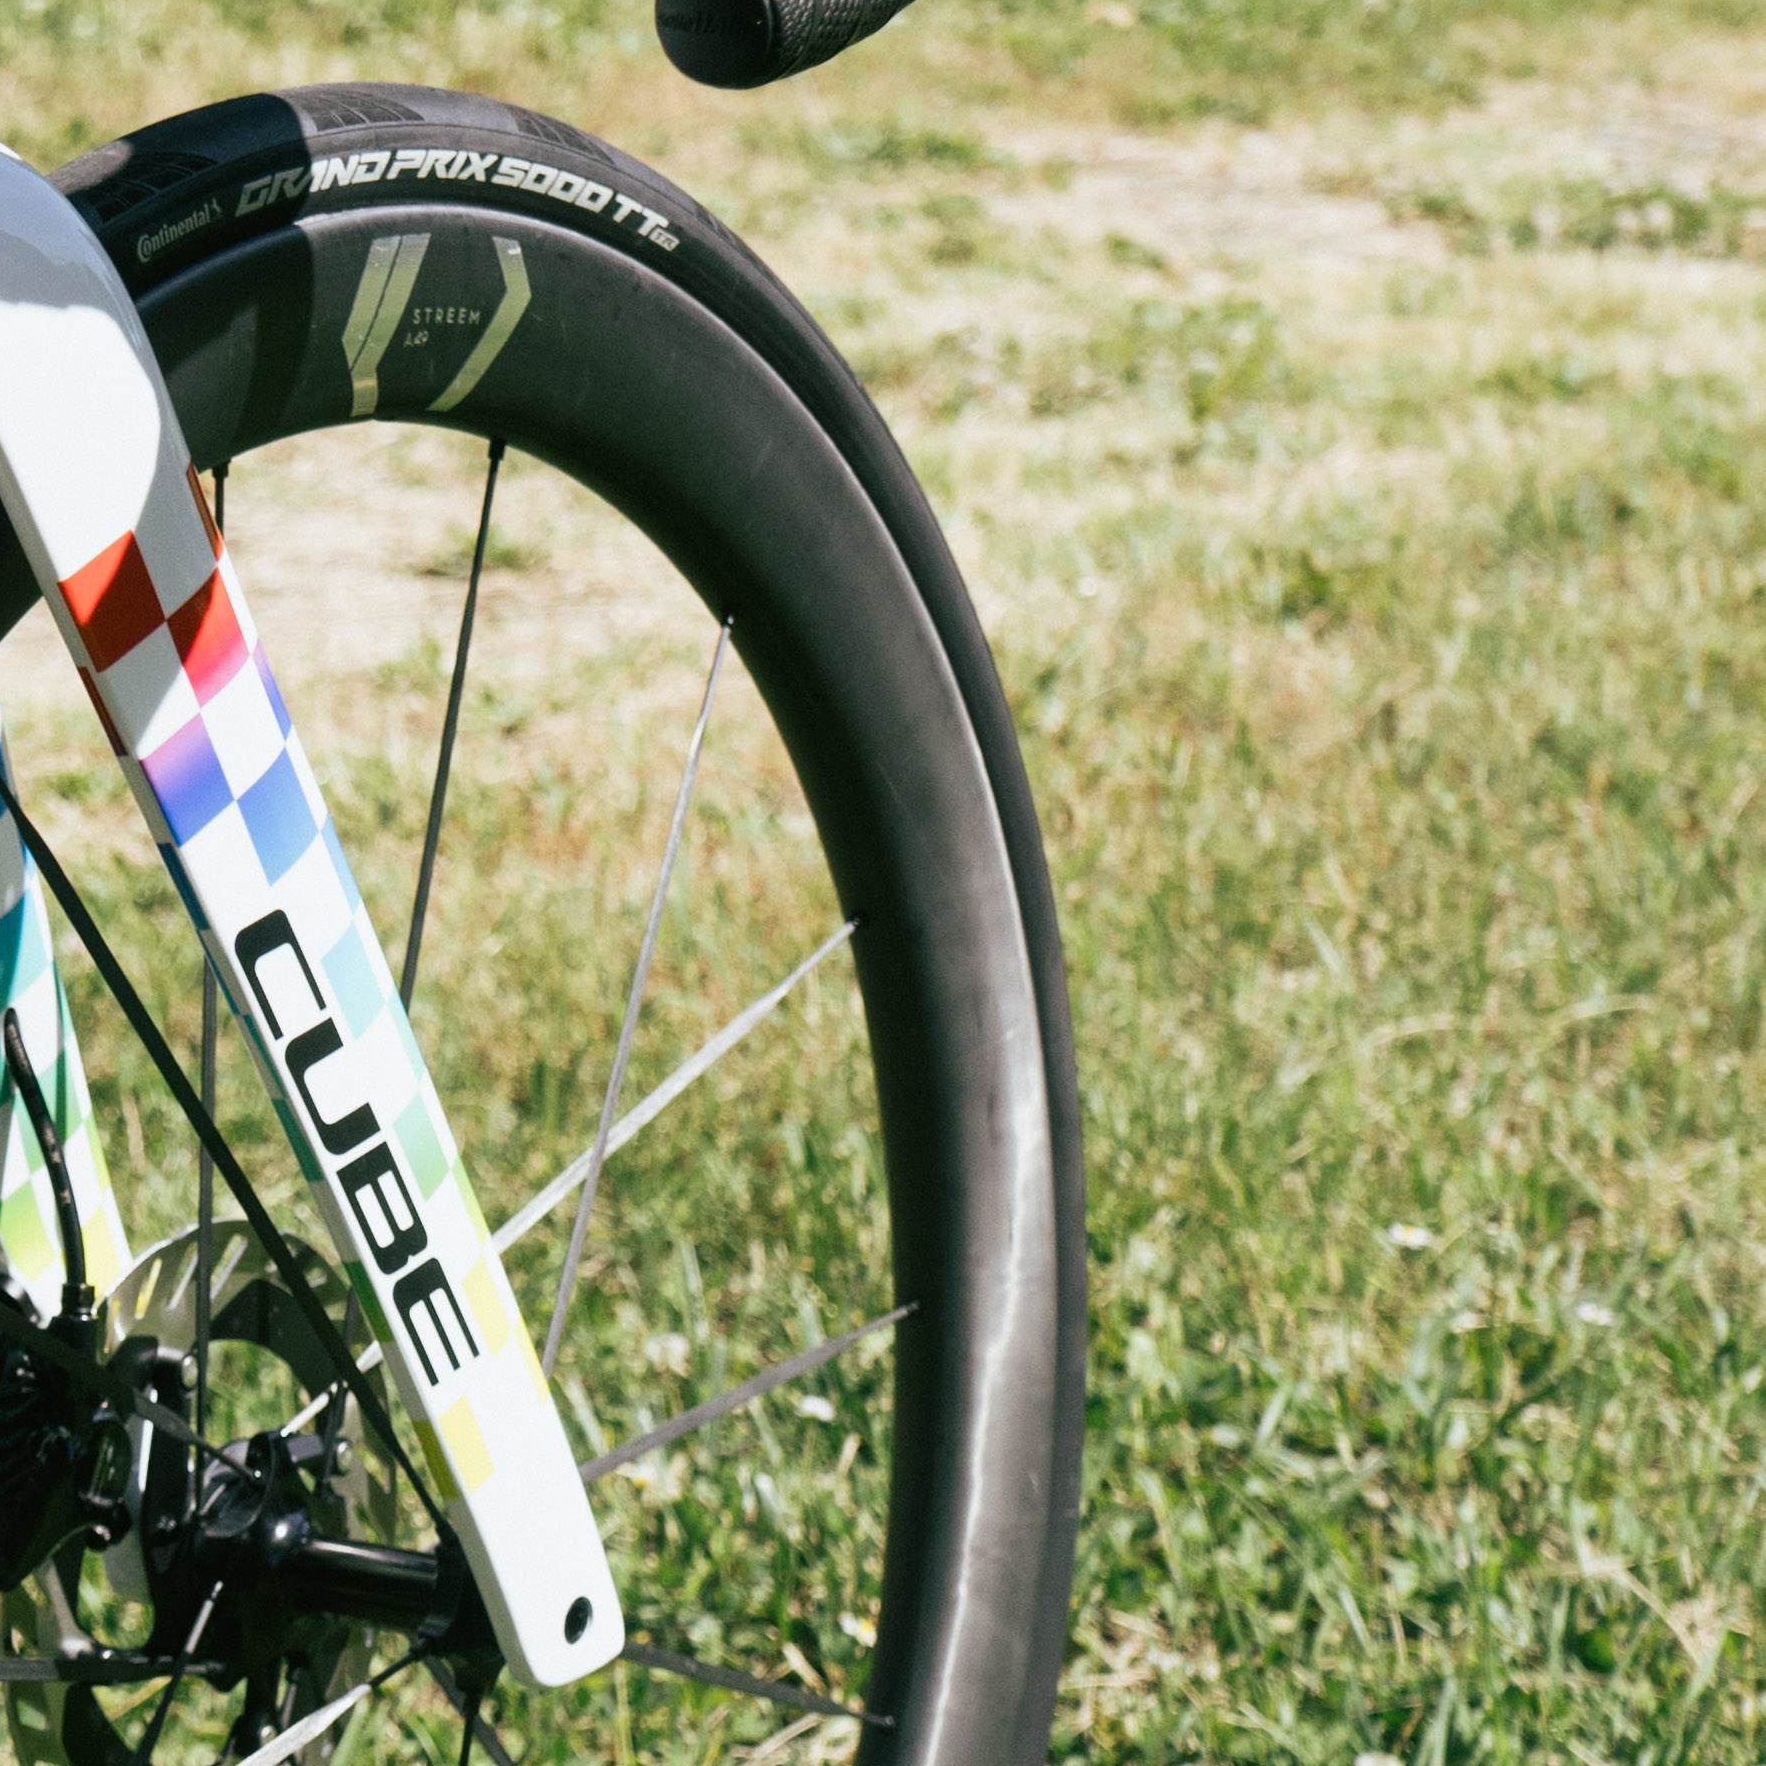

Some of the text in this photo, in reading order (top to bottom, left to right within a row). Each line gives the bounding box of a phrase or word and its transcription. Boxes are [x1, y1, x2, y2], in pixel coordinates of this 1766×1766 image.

[235, 150, 392, 218] GRAND
[386, 148, 499, 181] PRIX
[491, 156, 615, 214] 5000
[612, 192, 670, 237] TT
[137, 202, 211, 264] Continental
[412, 306, 481, 325] STREEM
[234, 908, 480, 1387] CUBE
